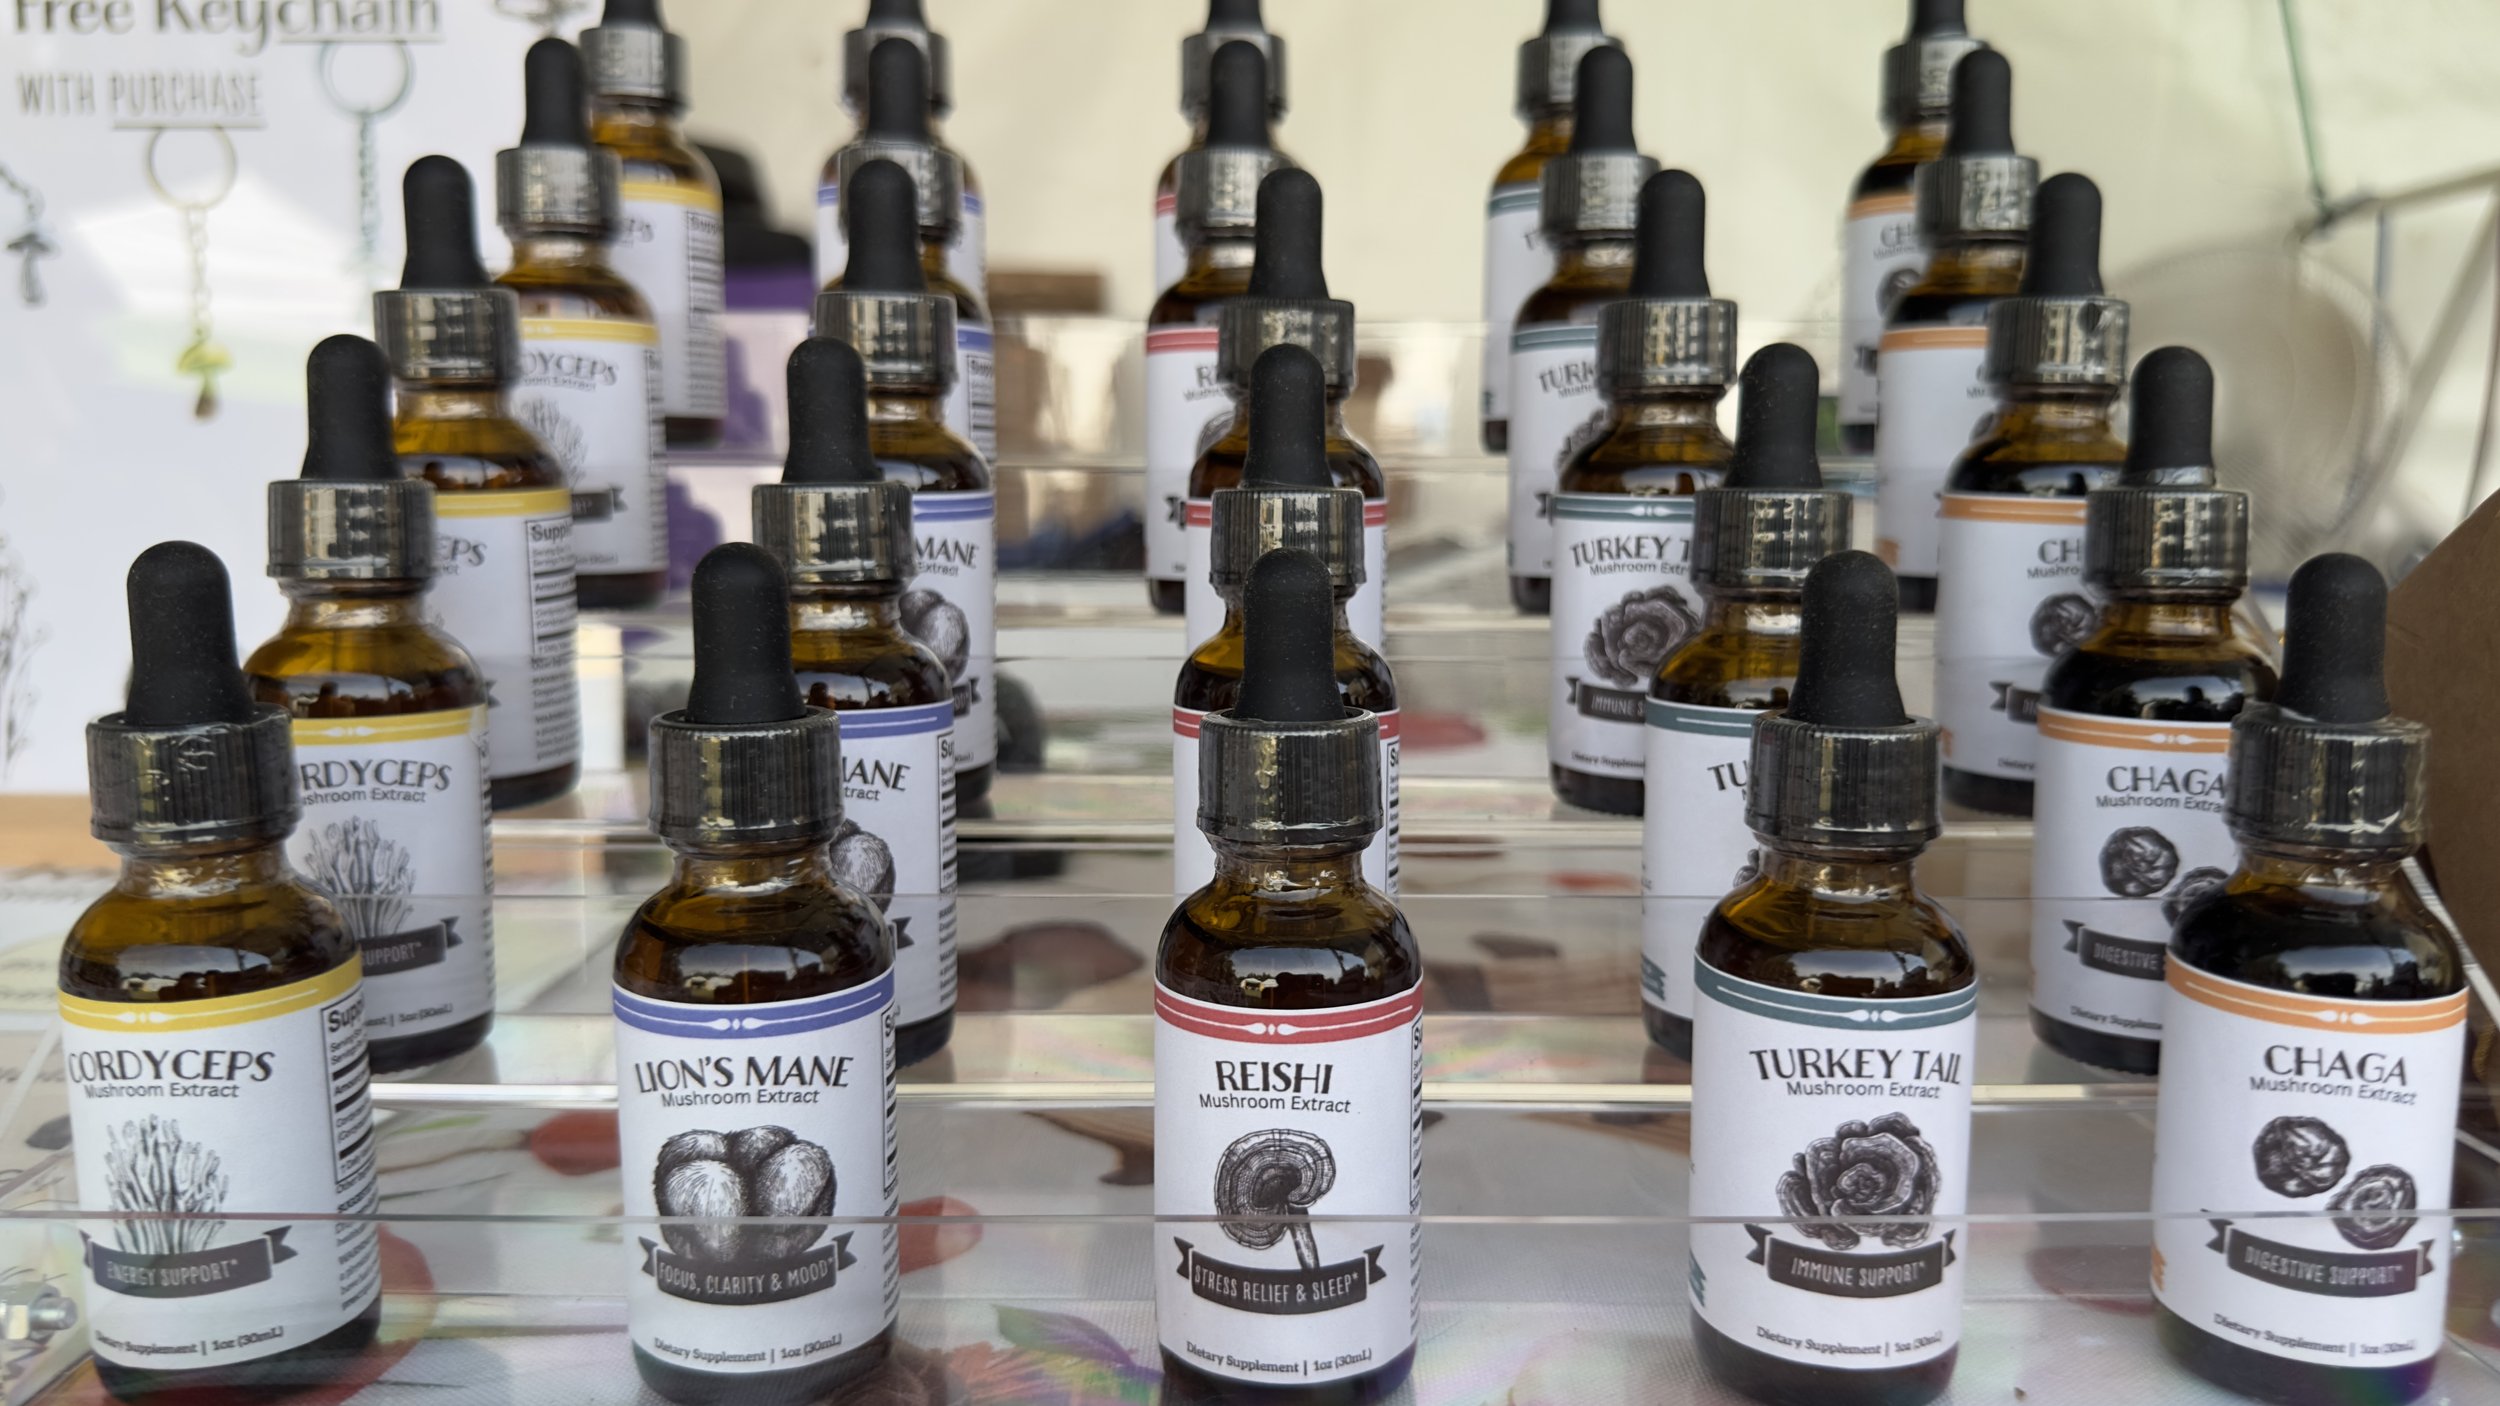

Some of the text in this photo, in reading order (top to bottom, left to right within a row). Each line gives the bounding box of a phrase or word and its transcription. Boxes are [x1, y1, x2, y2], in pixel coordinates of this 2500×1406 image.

[13, 0, 441, 57] Free Keychain
[16, 70, 263, 118] WITH PURCHASE
[1570, 536, 1670, 568] TURKEY
[1590, 562, 1656, 576] Mushroom
[2027, 565, 2081, 580] Mushro
[300, 759, 452, 791] RDYCEPS
[842, 757, 911, 791] ANE
[2106, 766, 2226, 798] CHAGA
[302, 787, 427, 806] shroom Extract
[844, 786, 881, 801] tract
[2096, 795, 2223, 813] Mushroom Extra
[2093, 943, 2160, 971] DIGESTIVE
[69, 1049, 276, 1083] CORDYCEPS
[634, 1056, 854, 1093] LION'S MANE
[1215, 1060, 1334, 1094] REISHI
[1749, 1048, 1962, 1086] TURKEY TAIL
[2263, 1045, 2408, 1087] CHAGA
[85, 1083, 239, 1099] Mushroom Extract
[661, 1089, 820, 1108] Mushroom Extract
[1199, 1093, 1351, 1114] Mushroom Extract
[1786, 1081, 1941, 1100] Mushroom Extract
[2250, 1076, 2418, 1106] Mushroom Extract
[107, 1261, 155, 1285] ENERGY
[658, 1262, 701, 1295] FOCUS,
[706, 1272, 765, 1295] CLARITY
[770, 1274, 783, 1292] &
[1791, 1257, 1854, 1286] IMMUNE
[2244, 1246, 2324, 1283] DIGESTIVE
[1194, 1264, 1238, 1297] STRESS
[1243, 1279, 1291, 1303] RELIEF
[1296, 1285, 1307, 1302] &
[1756, 1326, 1802, 1348] Dietary
[1805, 1338, 1881, 1356] Supplement
[2213, 1313, 2260, 1339] Dietary
[2263, 1330, 2346, 1354] Supplement
[654, 1337, 691, 1360] Dietary
[692, 1344, 766, 1364] Supplement
[781, 1348, 801, 1360] 1oz
[1186, 1341, 1224, 1367] Dietary
[1226, 1352, 1299, 1375] Supplement
[1313, 1357, 1333, 1371] 1oz
[1335, 1347, 1373, 1370] (30mL)
